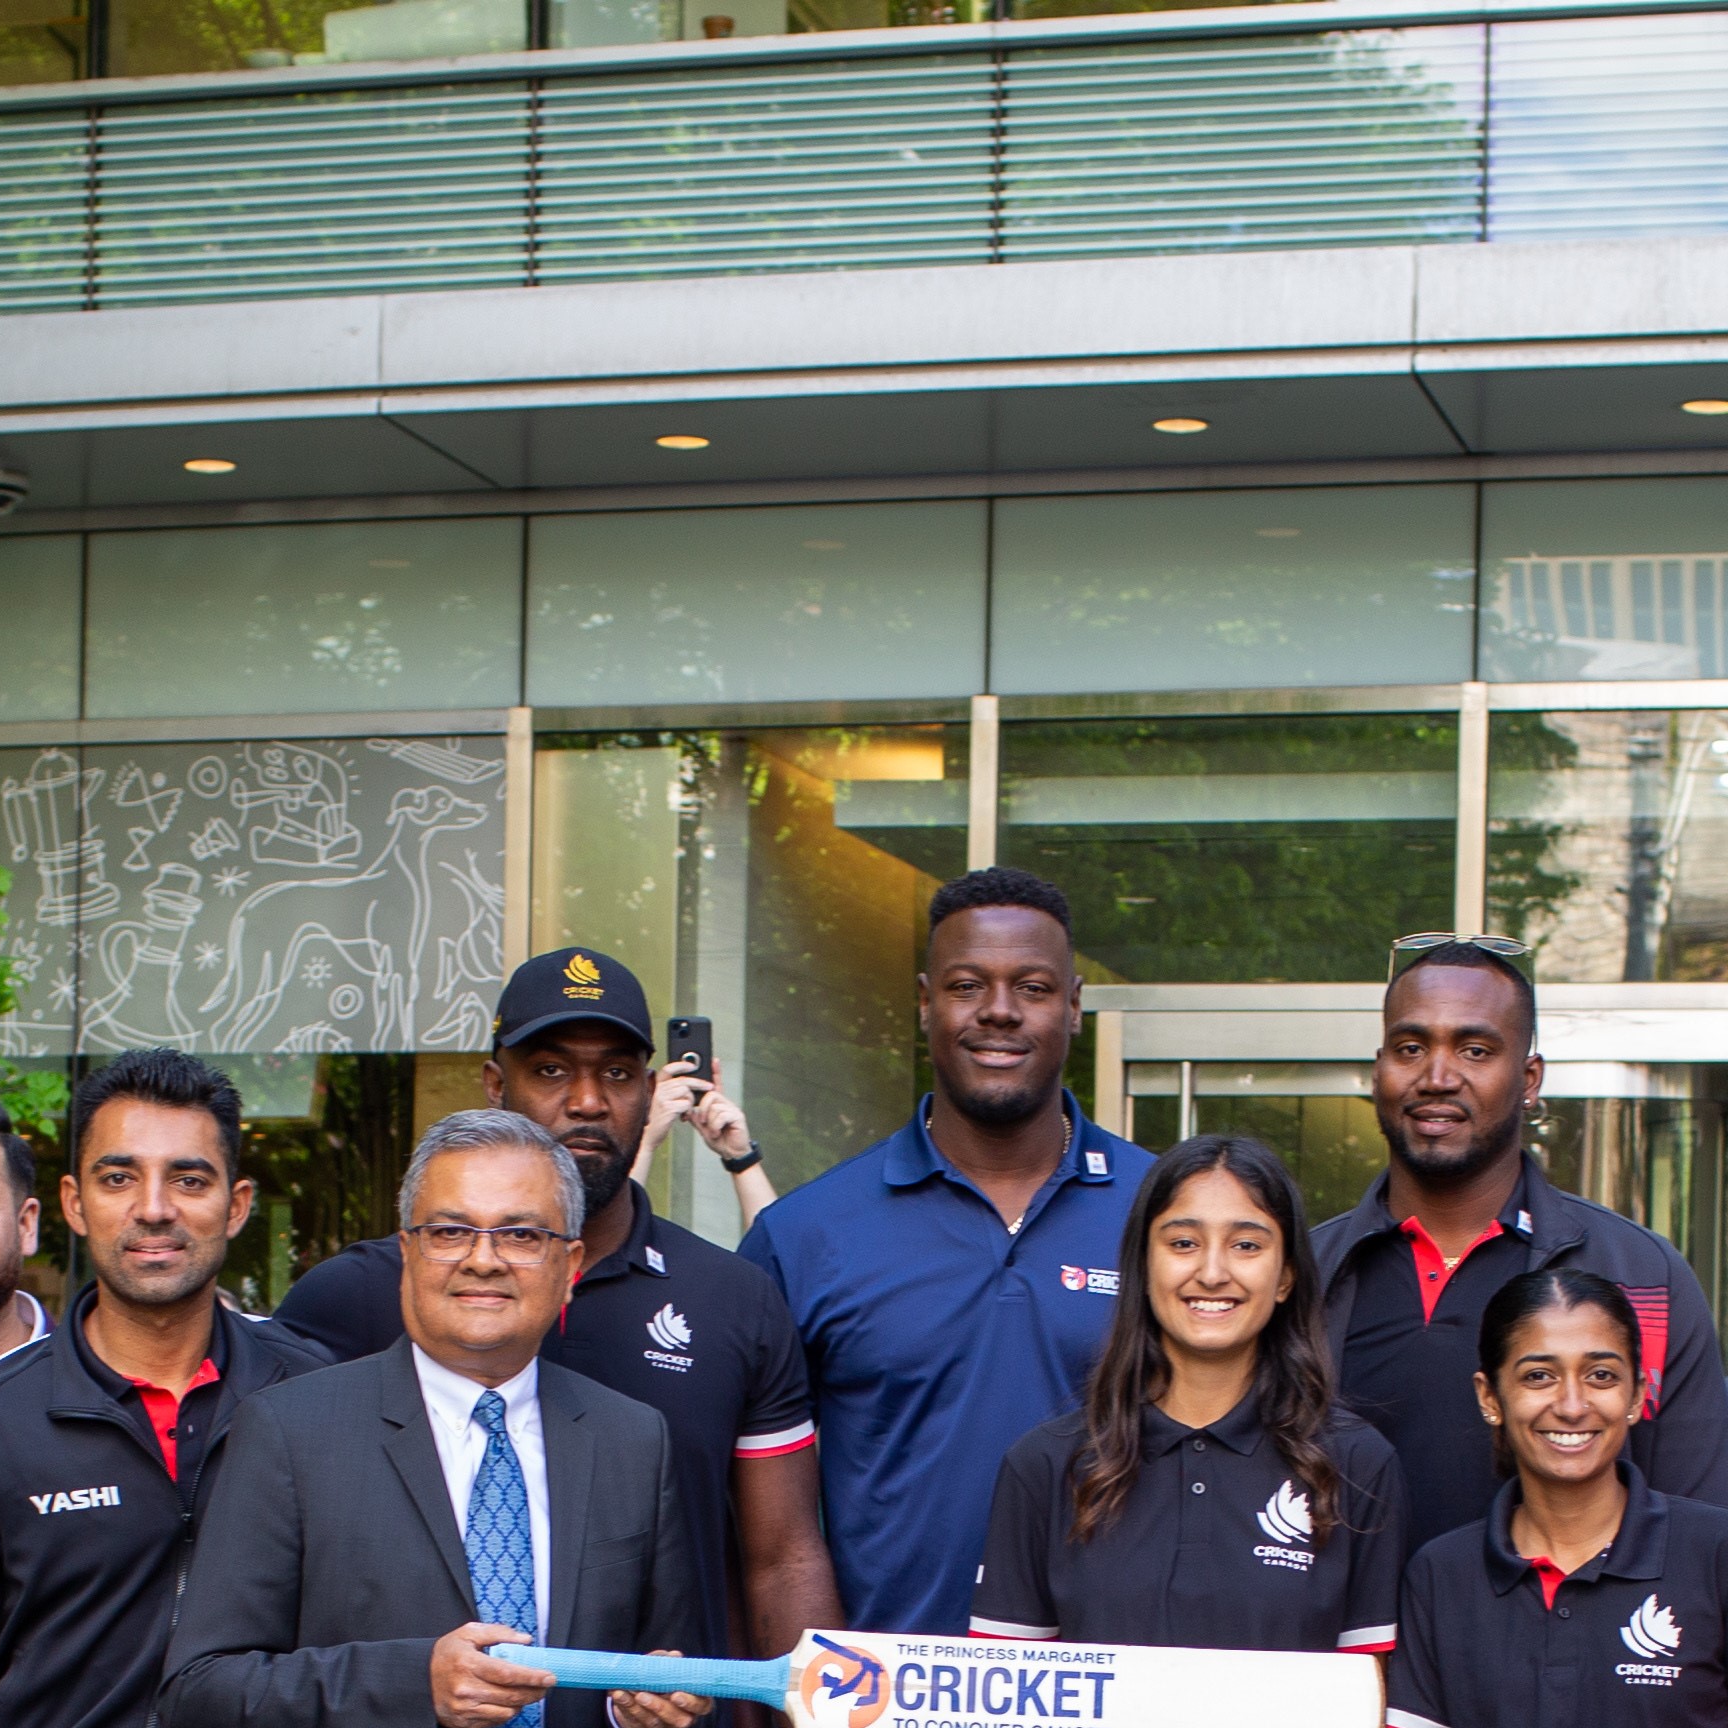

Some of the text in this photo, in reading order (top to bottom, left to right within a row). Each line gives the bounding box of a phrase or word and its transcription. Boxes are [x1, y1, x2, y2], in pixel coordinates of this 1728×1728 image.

[563, 986, 604, 996] CRICKET
[644, 1350, 694, 1367] CRICKET
[29, 1486, 121, 1515] YASHI
[1253, 1545, 1315, 1564] CRICKET
[1263, 1559, 1308, 1571] CANADA
[897, 1643, 1116, 1664] THE PRINCESS MARGARET
[1615, 1664, 1682, 1678] CRICKET
[894, 1662, 1115, 1719] CRICKET
[1625, 1678, 1672, 1686] CANADA
